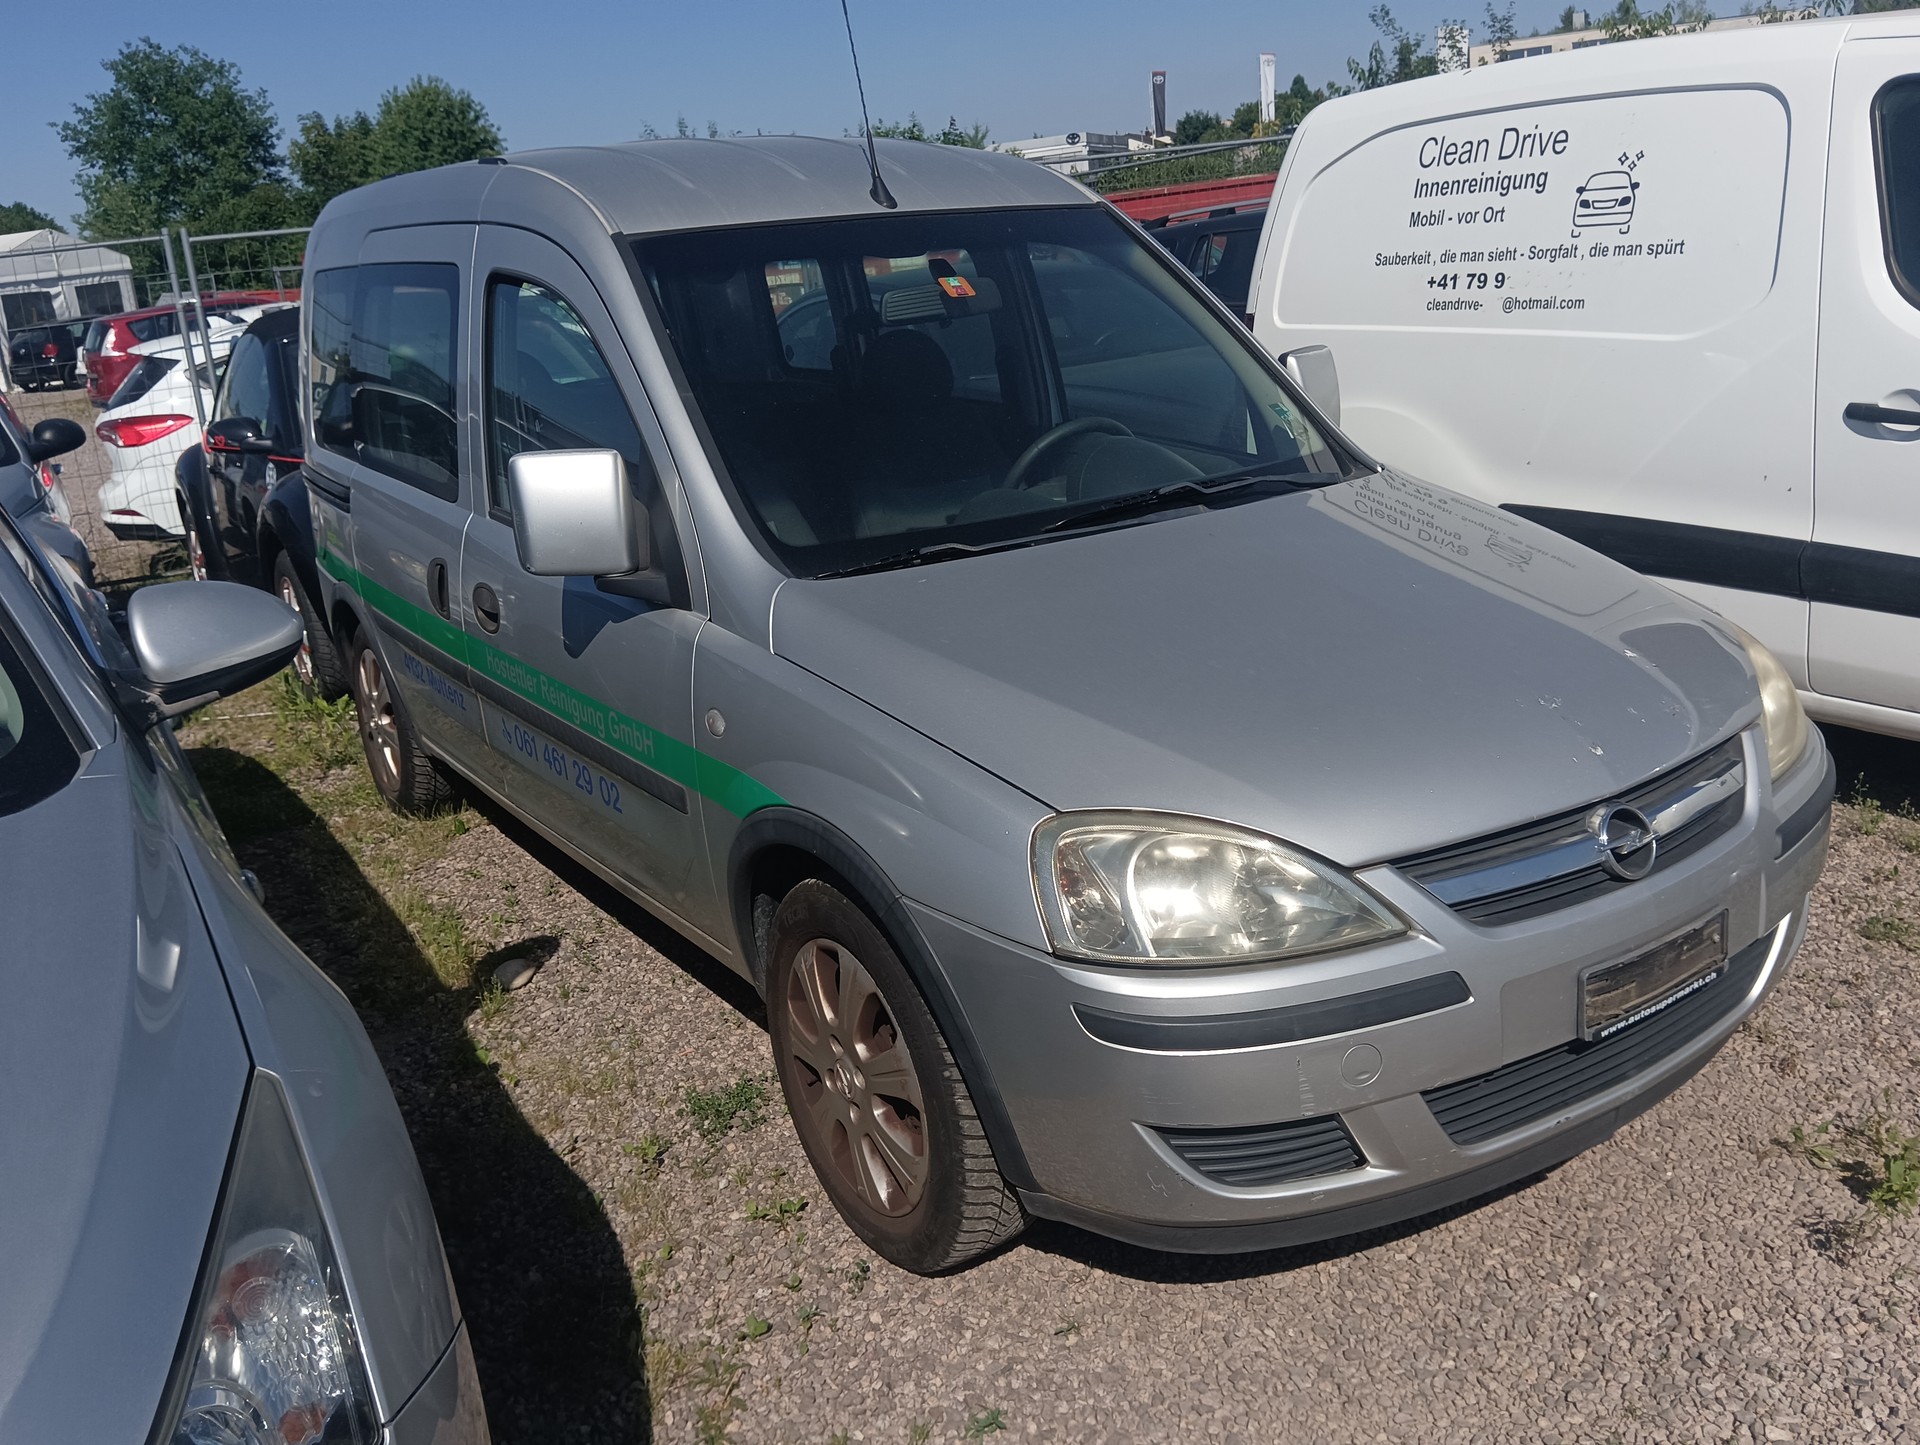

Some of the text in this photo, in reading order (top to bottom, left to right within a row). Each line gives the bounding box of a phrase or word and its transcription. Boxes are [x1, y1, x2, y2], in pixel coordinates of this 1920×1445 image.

[1418, 124, 1569, 169] Clean Drive
[1413, 170, 1549, 199] Innenreinigung
[1408, 209, 1445, 228] Mobil
[1456, 210, 1480, 225] vor
[1483, 206, 1506, 224] Ort
[1439, 250, 1457, 264] die
[1459, 251, 1485, 264] man
[1487, 246, 1518, 263] sieht
[1588, 242, 1610, 258] die
[1612, 244, 1643, 257] man
[1646, 238, 1686, 260] spürt
[1427, 273, 1458, 291] +41
[1466, 272, 1488, 290] 79
[1502, 295, 1585, 314] @hotmail.com
[404, 651, 467, 711] 4132 Muttenz
[485, 648, 655, 759] Hostettler Reinigung GmbH
[514, 724, 623, 814] 061 461 29 02
[1600, 972, 1718, 1038] www.autosupermarkt.ch
